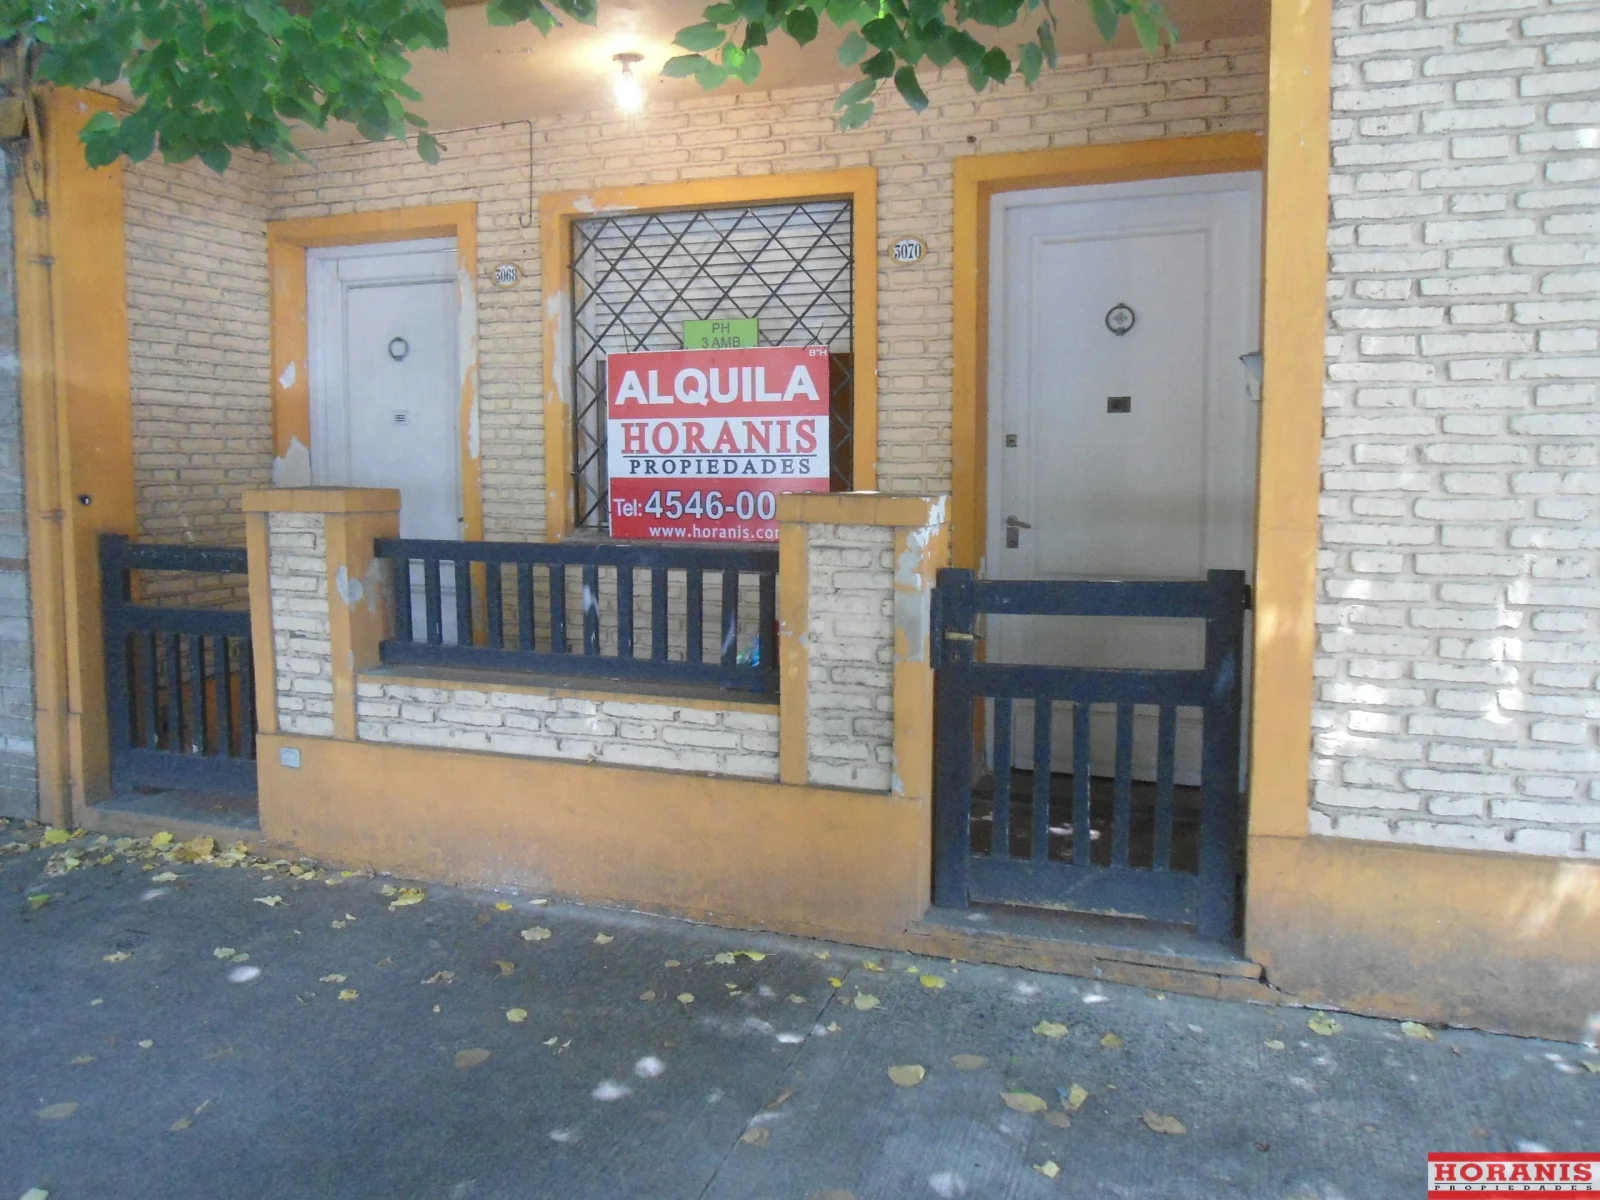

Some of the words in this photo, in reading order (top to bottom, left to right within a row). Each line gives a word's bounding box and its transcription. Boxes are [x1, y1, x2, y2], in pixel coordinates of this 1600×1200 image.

[894, 243, 922, 260] 3070
[495, 268, 518, 284] 3068
[711, 322, 730, 334] PH
[701, 337, 709, 349] 3
[711, 336, 741, 348] AMB
[614, 365, 820, 406] ALQUILA
[620, 419, 818, 454] HORANIS
[629, 458, 811, 475] PROPIEDADES
[613, 498, 642, 517] Tel:
[644, 490, 813, 520] 4546-00
